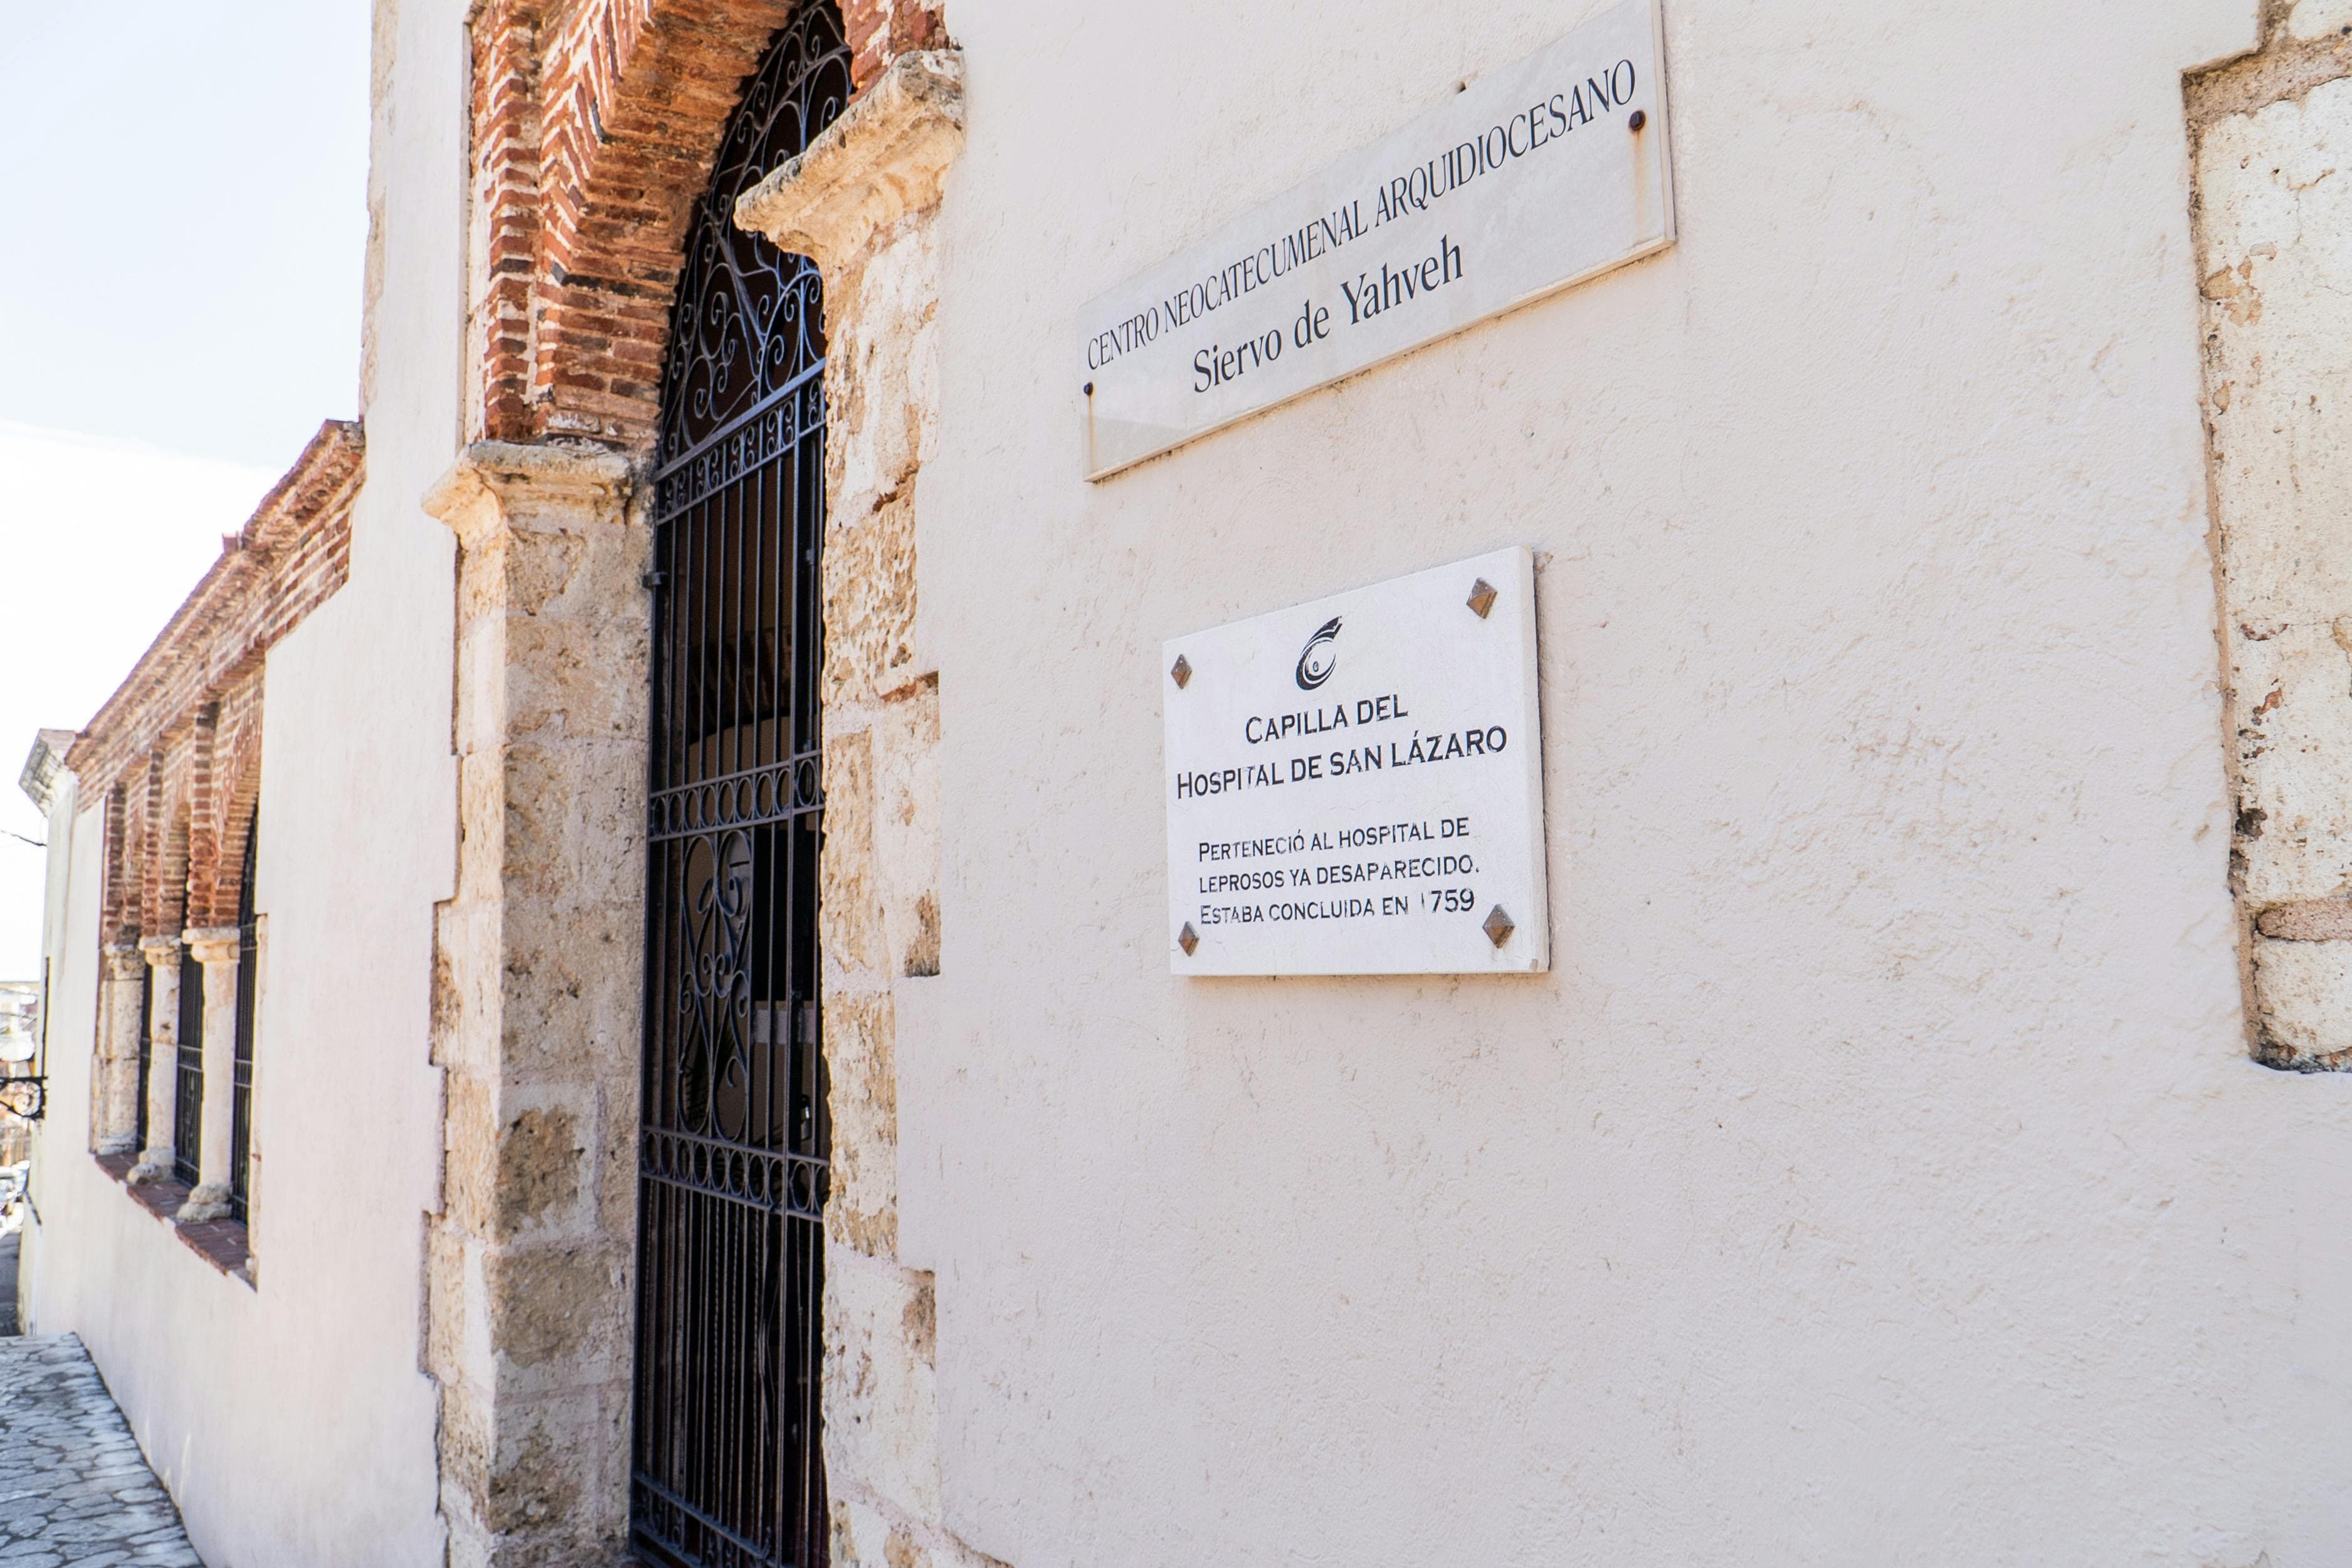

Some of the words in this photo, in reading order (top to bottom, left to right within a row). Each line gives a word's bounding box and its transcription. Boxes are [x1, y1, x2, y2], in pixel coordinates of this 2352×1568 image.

[1088, 307, 1158, 370] CENTRO
[1164, 200, 1368, 333] NEOCATECUMENAL
[1376, 60, 1635, 228] ARQUIDIOCESANO
[1194, 330, 1282, 392] Siervo
[1294, 299, 1330, 348] de
[1341, 234, 1463, 325] Yahveh
[1246, 705, 1349, 744] CAPILLA
[1357, 694, 1408, 725] DEL
[1178, 762, 1284, 799] HOSPITAL
[1291, 754, 1322, 782] DE
[1330, 745, 1382, 776] SAN
[1391, 725, 1507, 767] LÁZARO
[1200, 829, 1304, 862] PERTENECIÓ
[1310, 833, 1333, 851] AL
[1339, 821, 1435, 848] HOSPITAL
[1441, 817, 1470, 838] DE
[1200, 870, 1284, 893] LEPROSOS
[1289, 868, 1311, 887] YA
[1317, 855, 1479, 885] DESAPARECIDO.
[1201, 905, 1264, 925] ESTABA
[1269, 898, 1374, 921] CONCLUIDA
[1383, 896, 1408, 915] EN
[1421, 888, 1474, 913] 1759
